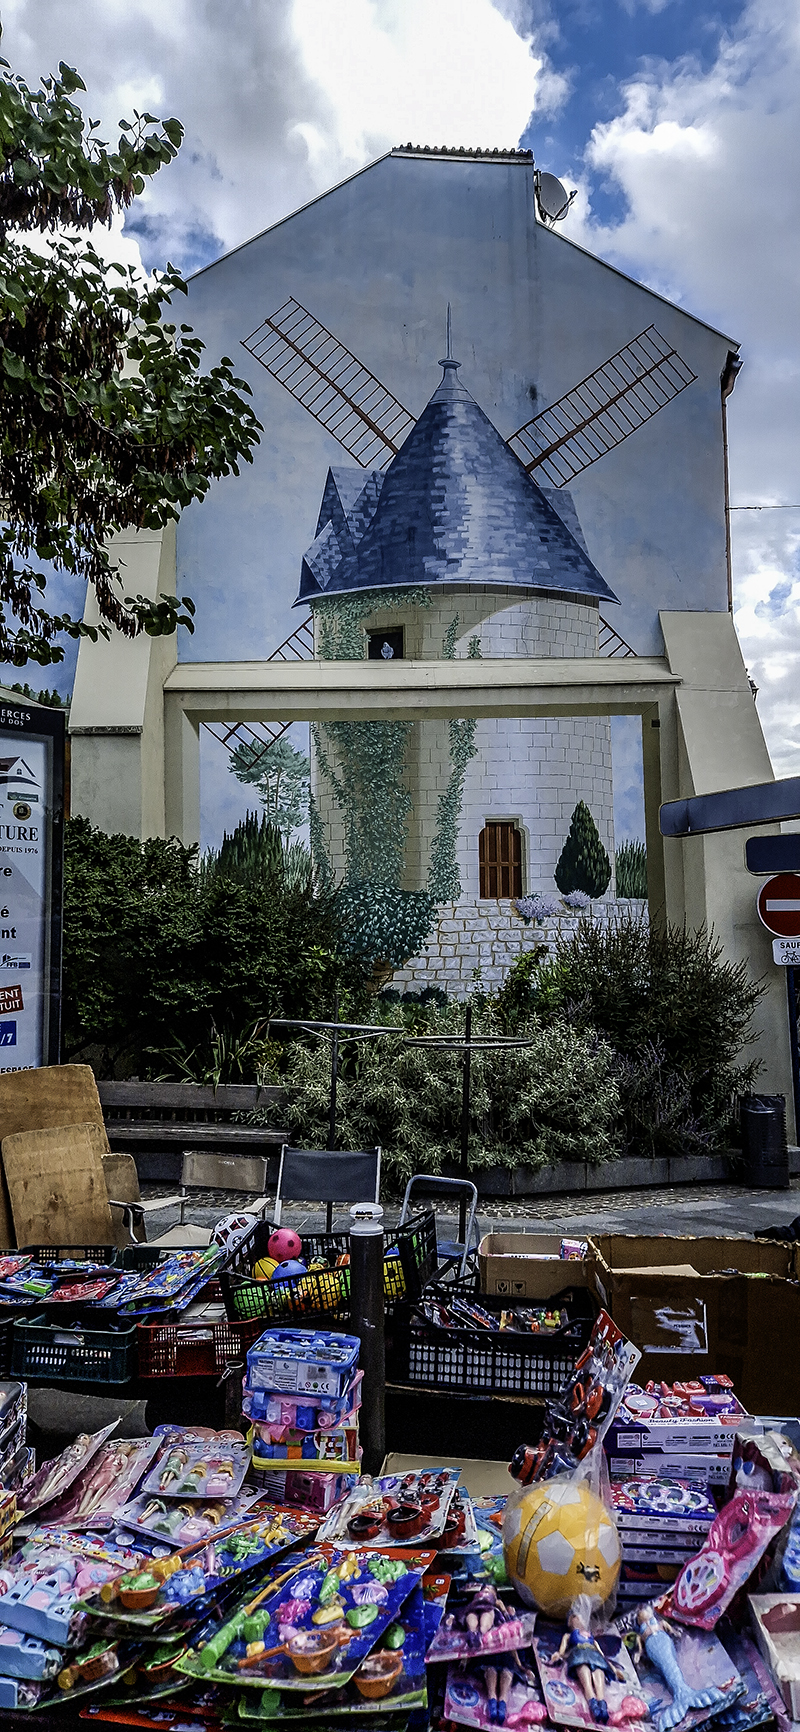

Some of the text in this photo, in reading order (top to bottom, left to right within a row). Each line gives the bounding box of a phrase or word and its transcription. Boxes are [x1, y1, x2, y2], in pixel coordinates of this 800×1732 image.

[1, 709, 31, 721] ERCES
[8, 718, 24, 727] DOS
[0, 905, 10, 918] é
[1, 927, 17, 939] nt
[0, 988, 19, 1000] ENT
[0, 1000, 21, 1011] TUIT
